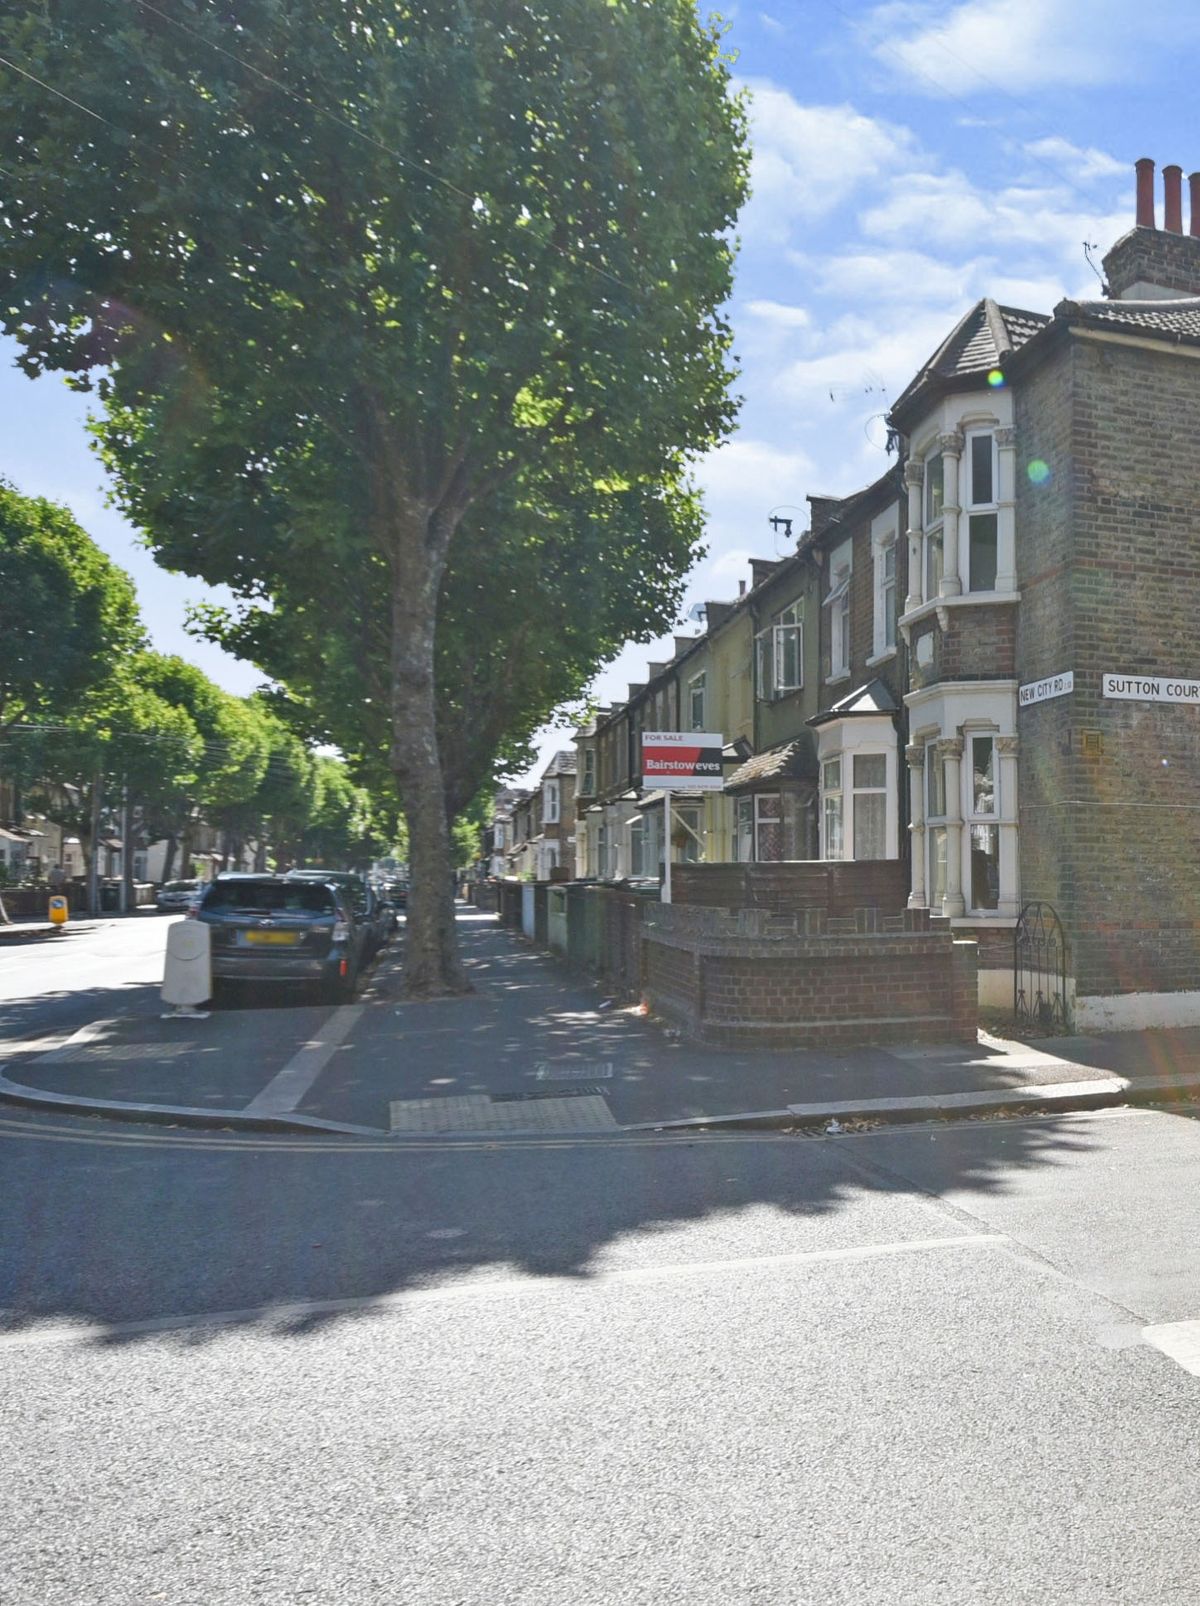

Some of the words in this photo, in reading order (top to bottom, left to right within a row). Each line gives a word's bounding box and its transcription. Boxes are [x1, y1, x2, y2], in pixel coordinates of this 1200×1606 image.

[1020, 687, 1035, 703] NEW
[1037, 682, 1053, 697] CITY
[1054, 678, 1064, 692] RD
[1107, 679, 1160, 696] SUTTON
